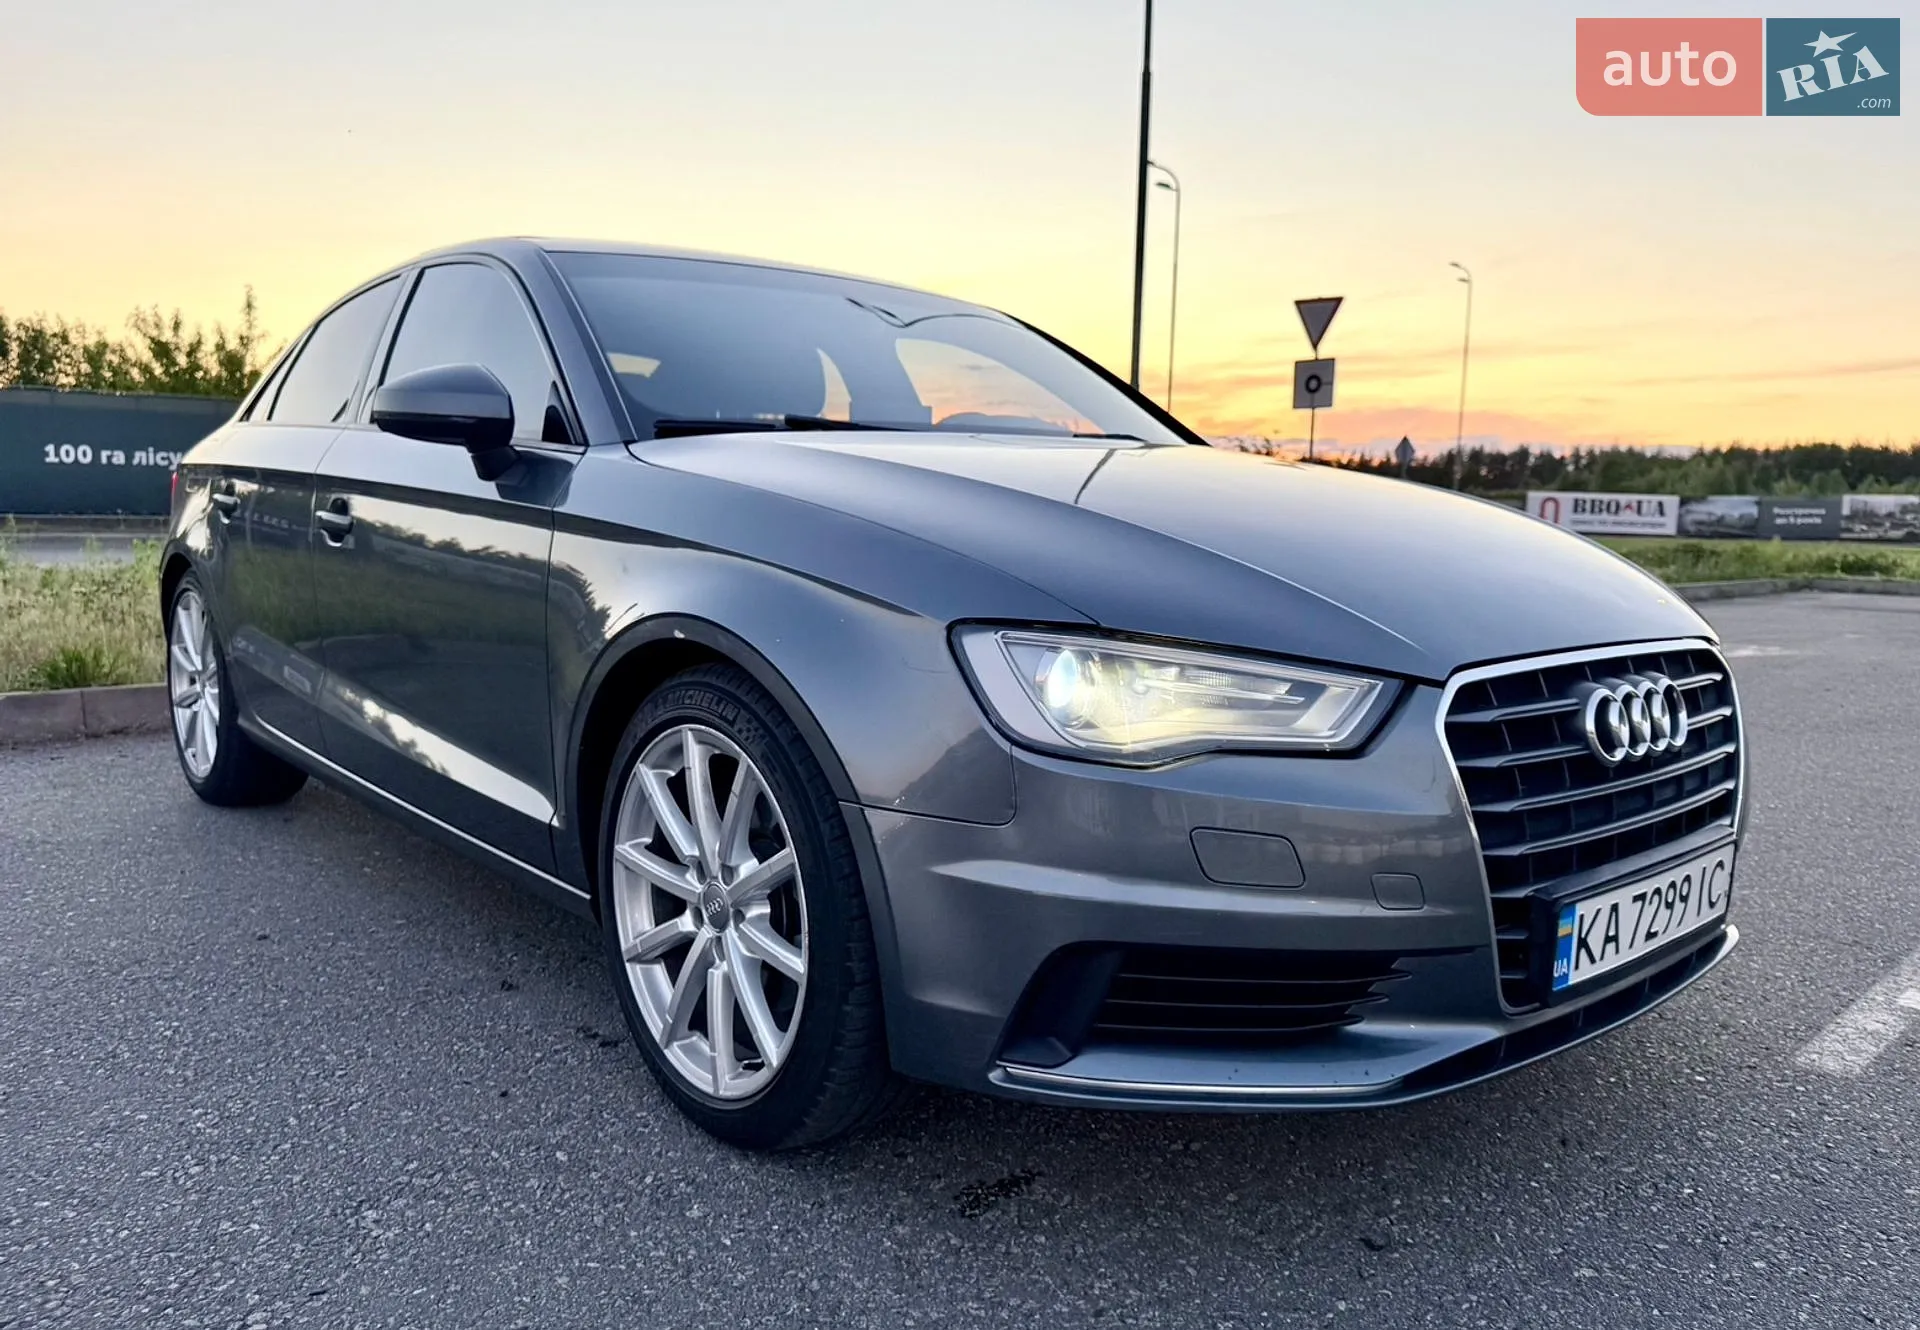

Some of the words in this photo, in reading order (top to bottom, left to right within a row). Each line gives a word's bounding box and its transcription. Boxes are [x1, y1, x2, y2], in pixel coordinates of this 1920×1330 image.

[44, 443, 93, 465] 100
[100, 449, 126, 467] га
[132, 446, 183, 472] лісу
[664, 689, 740, 721] MICHELIN
[1574, 902, 1620, 971] KA
[1628, 873, 1692, 950] 7299
[1697, 859, 1725, 917] IC
[1553, 960, 1569, 977] UA
